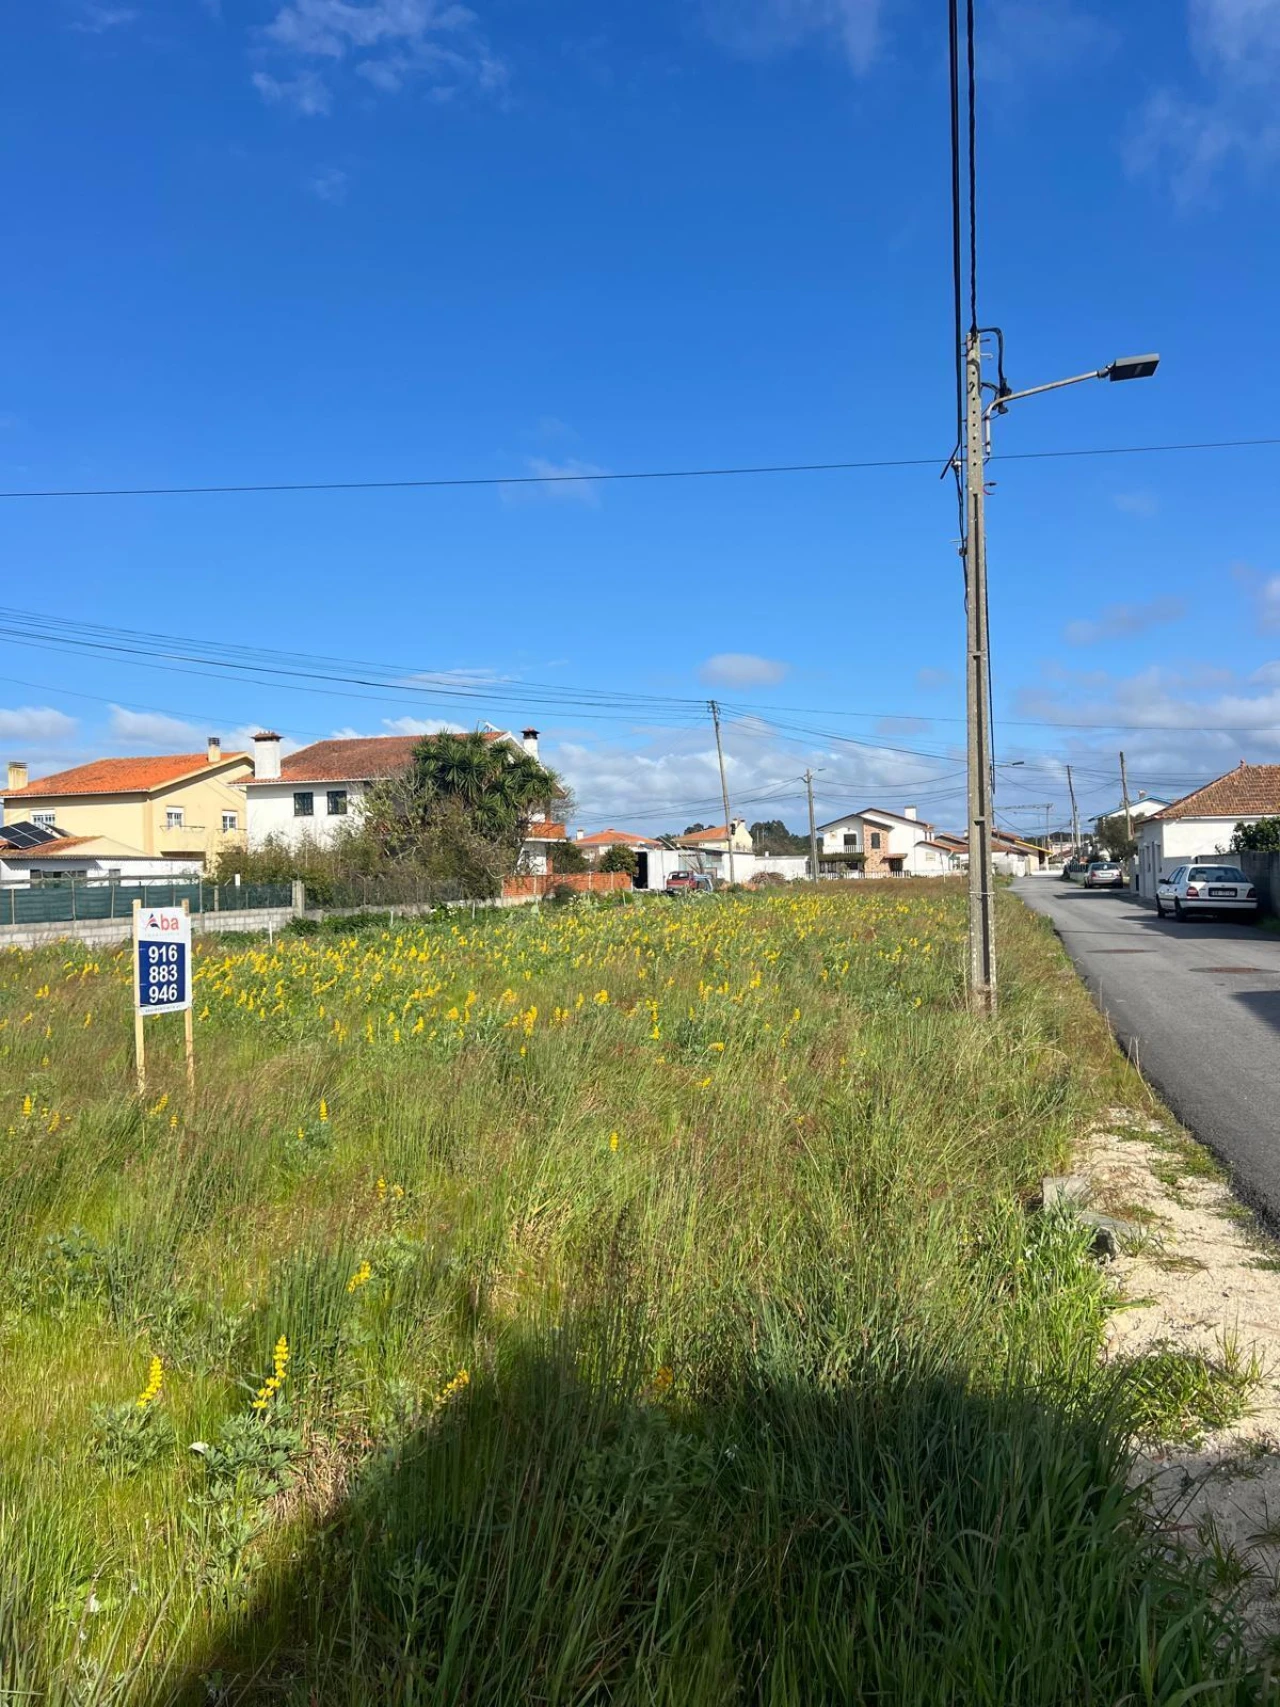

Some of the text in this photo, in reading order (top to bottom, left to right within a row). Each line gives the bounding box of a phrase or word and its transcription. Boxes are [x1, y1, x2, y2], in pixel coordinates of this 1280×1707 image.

[148, 944, 178, 964] 916
[149, 964, 178, 983] 883
[149, 983, 178, 1004] 946
